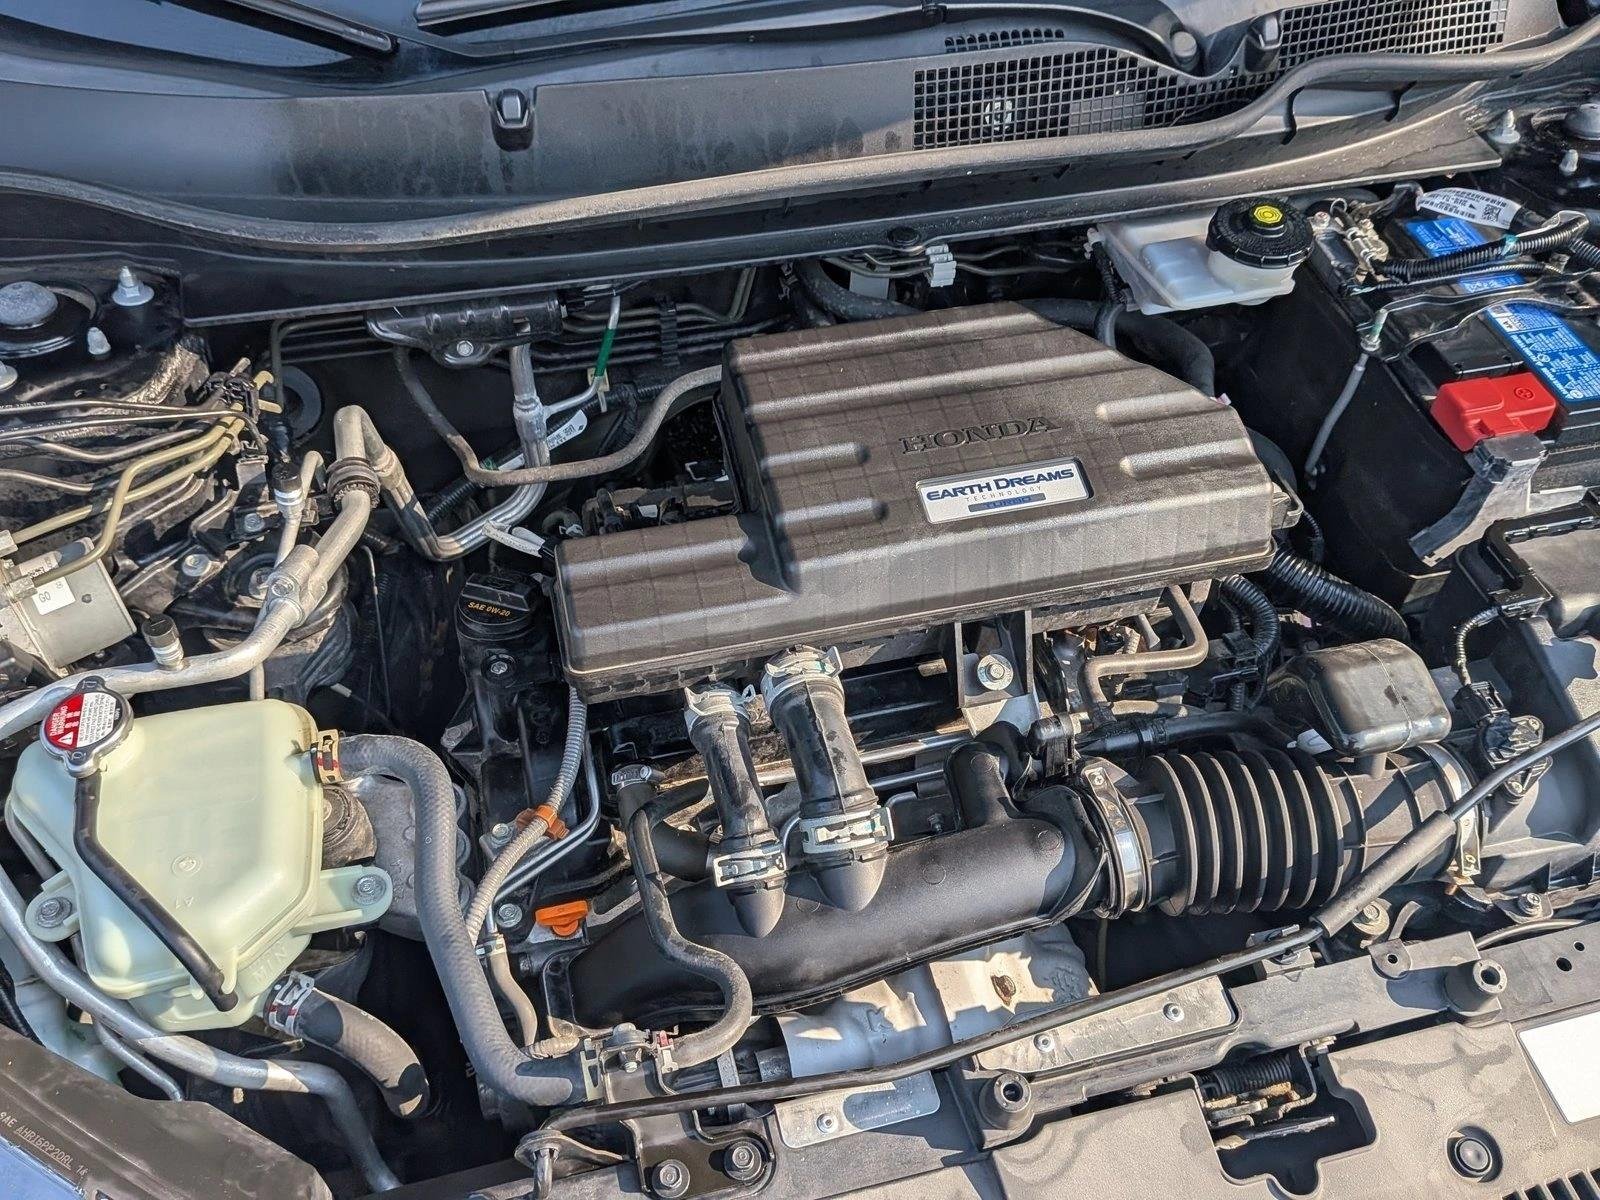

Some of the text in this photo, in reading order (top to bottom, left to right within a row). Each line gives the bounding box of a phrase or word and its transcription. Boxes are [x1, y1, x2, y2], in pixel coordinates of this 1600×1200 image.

[899, 416, 1062, 454] HONDA
[927, 479, 992, 501] EARTH
[966, 486, 1041, 502] TECHNOLOGY
[468, 602, 510, 617] SAE 0W-20
[50, 712, 60, 736] DANGER
[58, 706, 69, 735] WARNING
[0, 1112, 17, 1128] SAE
